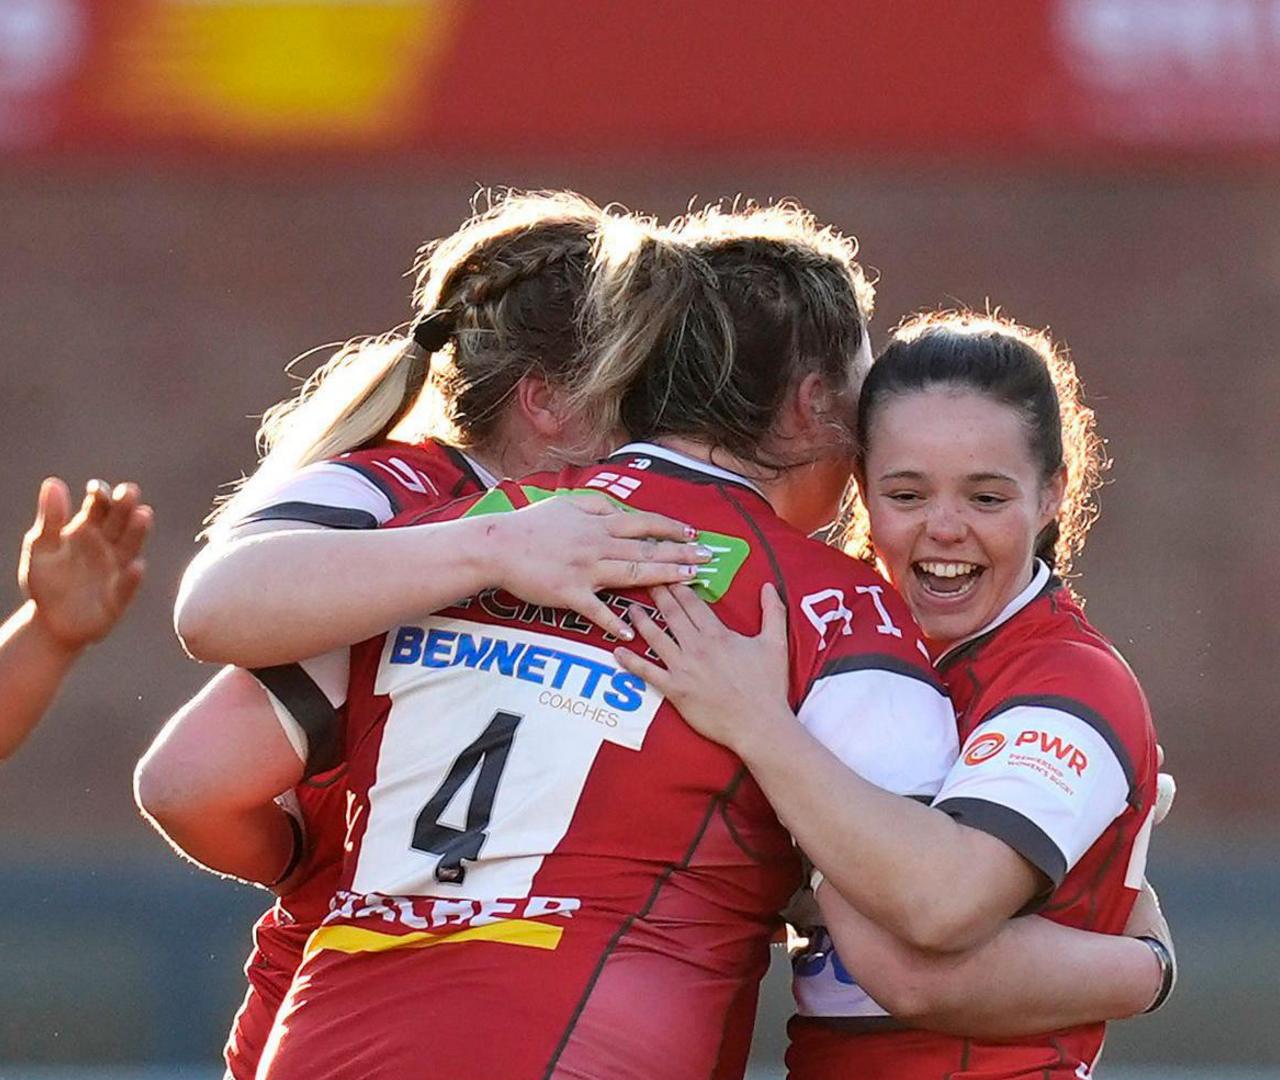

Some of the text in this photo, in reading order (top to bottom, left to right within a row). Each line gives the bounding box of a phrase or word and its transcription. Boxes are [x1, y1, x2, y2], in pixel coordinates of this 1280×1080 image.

[389, 624, 648, 713] BENNETTS
[538, 690, 620, 729] COACHES
[1014, 730, 1087, 779] PWR
[409, 708, 524, 887] 4
